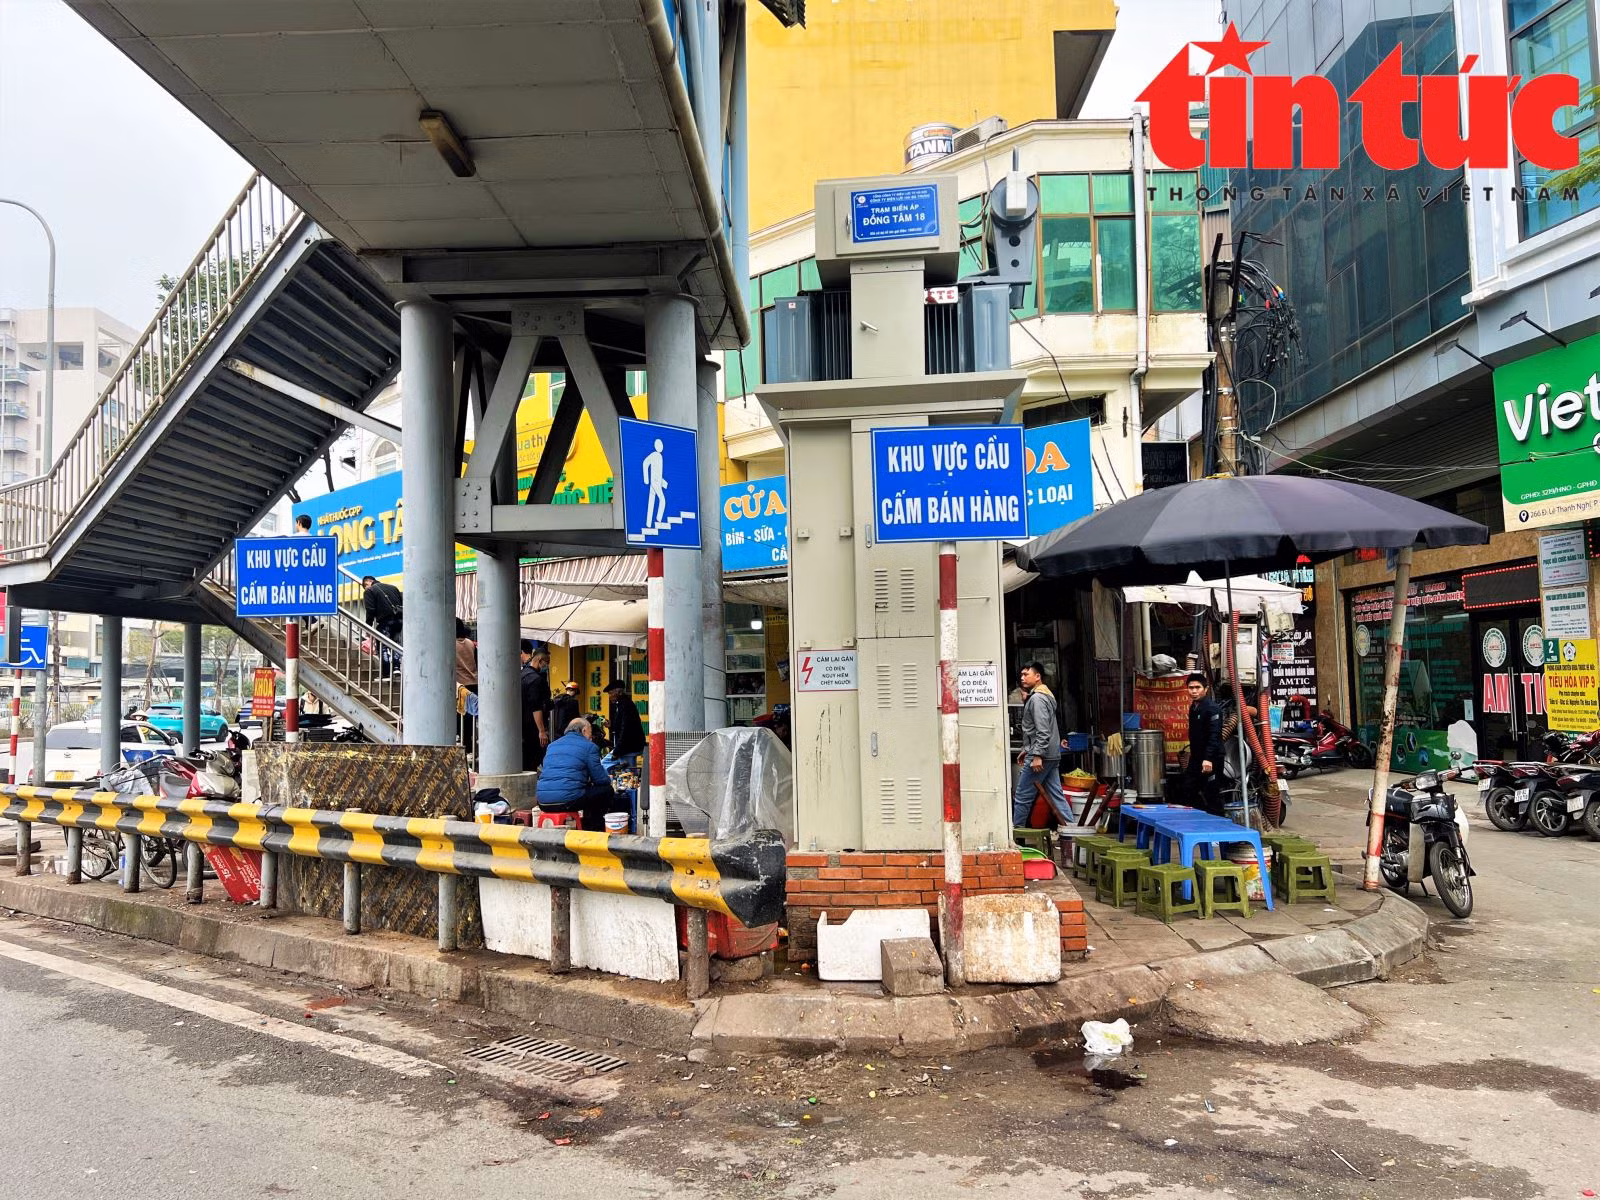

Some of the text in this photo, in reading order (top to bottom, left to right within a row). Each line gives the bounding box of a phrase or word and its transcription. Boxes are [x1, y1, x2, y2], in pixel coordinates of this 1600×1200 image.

[871, 206, 890, 215] TRẠM
[910, 203, 919, 211] ÁP
[915, 212, 925, 221] 18
[887, 435, 1010, 477] KHU VỰC CẦU
[724, 484, 788, 522] CỬA
[1038, 483, 1073, 505] LOẠI
[881, 489, 1019, 525] CẤM BÁN HÀNG
[1557, 503, 1575, 514] Thanh
[317, 516, 376, 556] ONG
[754, 524, 775, 542] SỮA
[246, 549, 271, 569] KHU
[275, 547, 299, 572] VỰC
[302, 542, 327, 568] CẦU
[241, 580, 333, 605] CẤM BÁN HÀNG
[1548, 641, 1554, 654] 2
[1564, 672, 1578, 688] HÓA
[1579, 676, 1590, 688] VIP
[1591, 676, 1596, 688] 9
